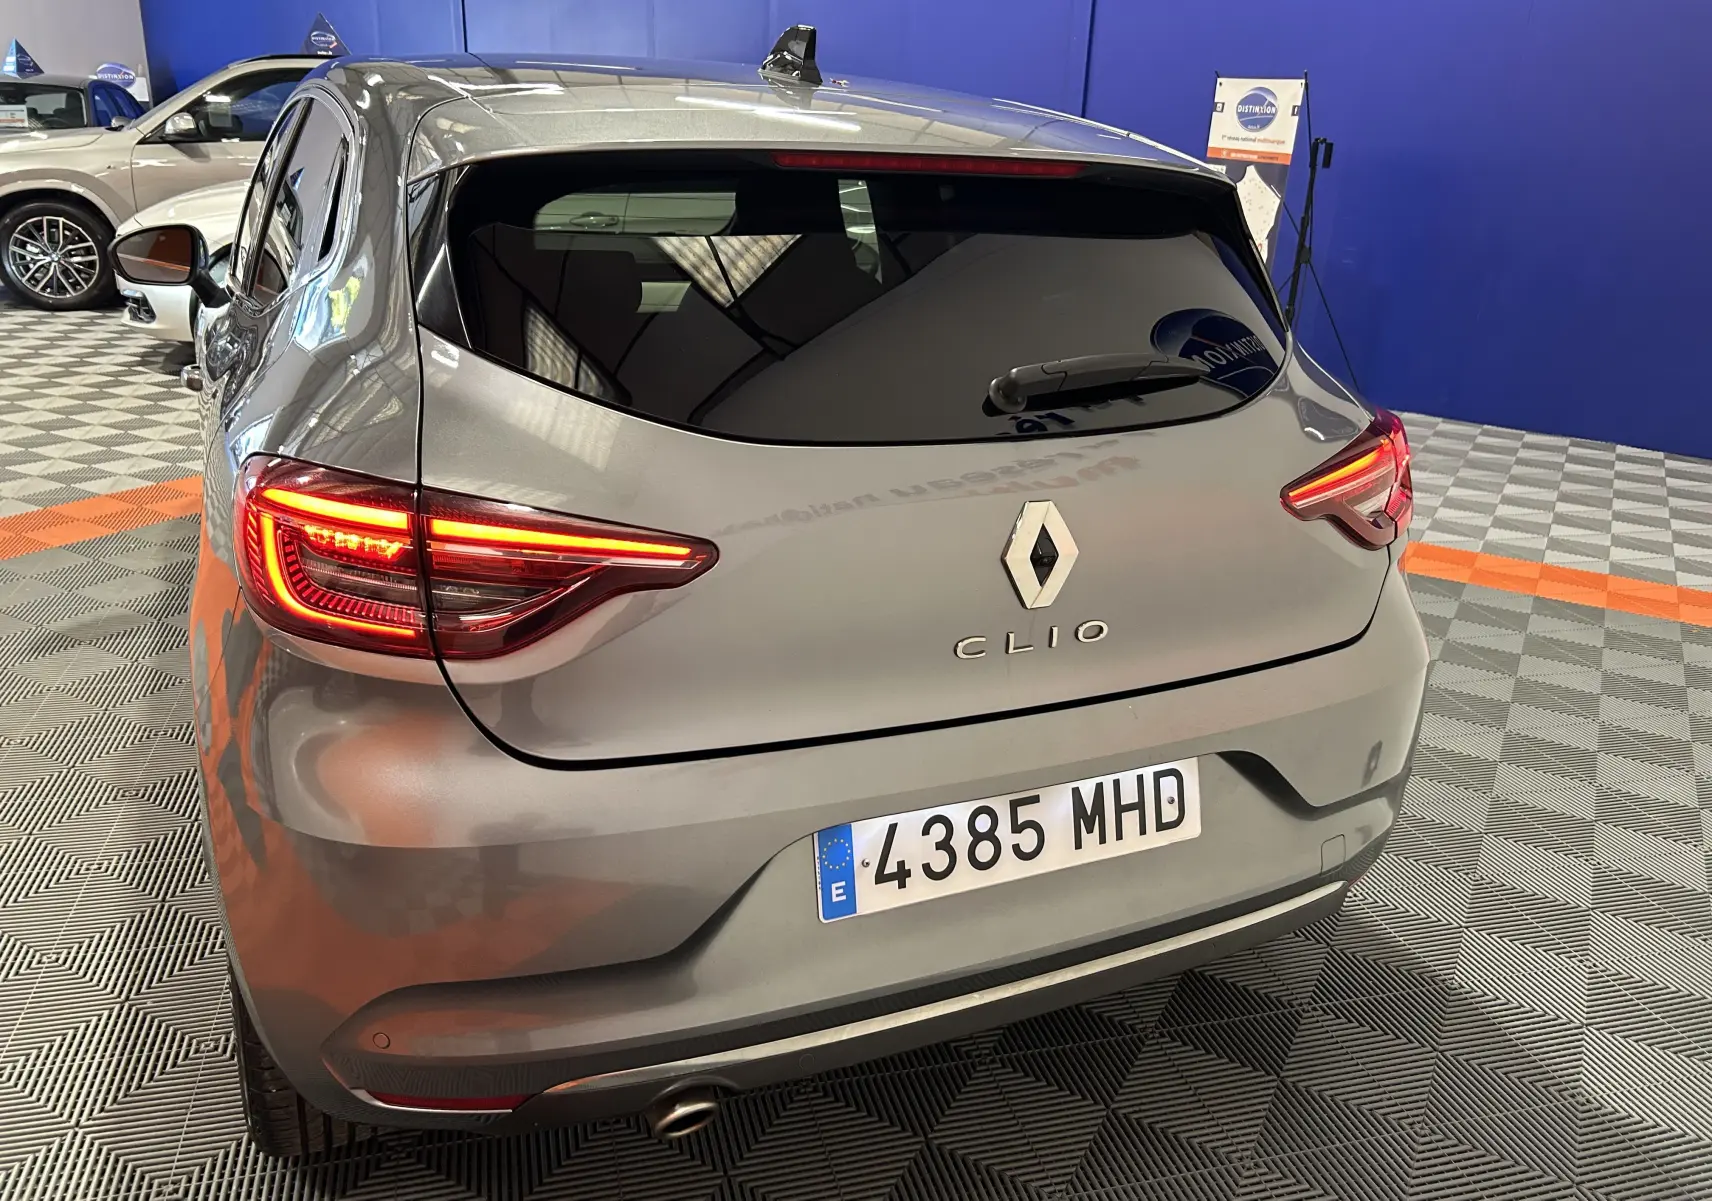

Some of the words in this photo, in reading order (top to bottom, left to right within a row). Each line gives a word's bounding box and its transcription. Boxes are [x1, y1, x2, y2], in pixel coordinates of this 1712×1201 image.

[1237, 104, 1276, 115] DISTINXION
[953, 619, 1109, 660] CLIO
[874, 794, 1046, 890] 4385
[1071, 767, 1186, 851] MHD
[831, 880, 847, 903] E
